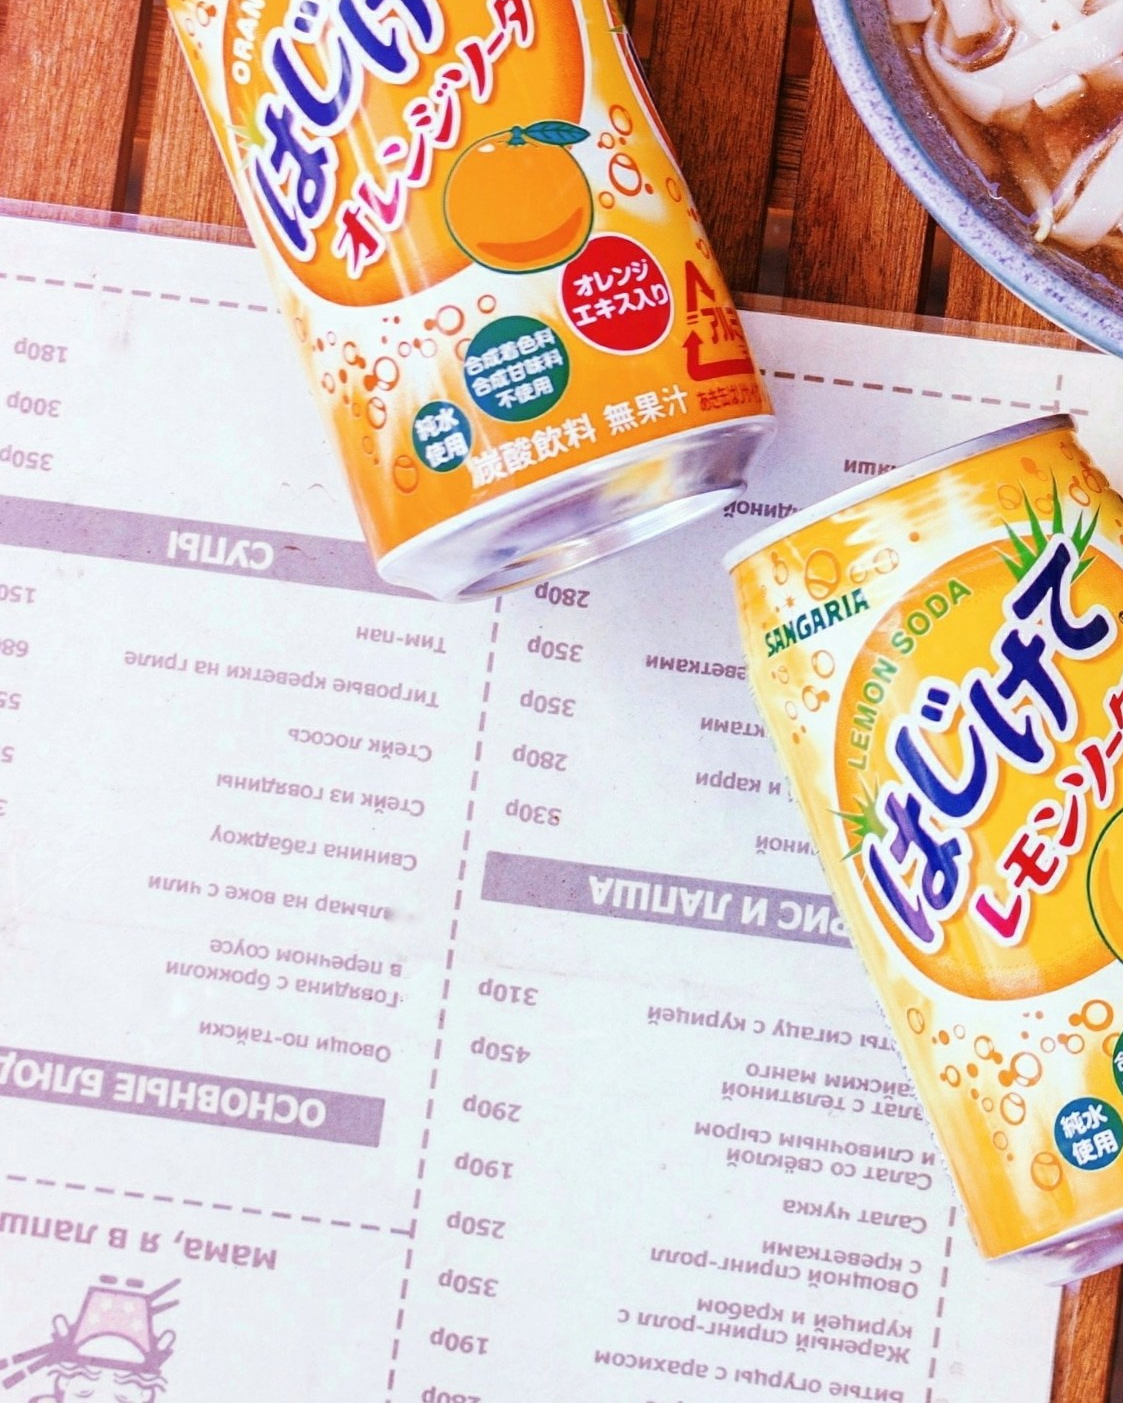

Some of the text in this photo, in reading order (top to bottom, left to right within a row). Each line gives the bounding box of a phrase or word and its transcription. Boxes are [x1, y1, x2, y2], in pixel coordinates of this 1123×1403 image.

[572, 257, 650, 298] オレンジ
[571, 283, 670, 327] エキス入り
[12, 336, 69, 364] 180р
[464, 327, 556, 377] 合成着色料
[471, 348, 564, 398] 合成甘味料
[4, 389, 62, 419] 300р
[495, 375, 555, 411] 不使用
[423, 432, 470, 469] 使用
[470, 384, 690, 490] 炭酸飲料 無果汁
[165, 529, 275, 571] СУПЫ
[532, 579, 591, 609] 280р
[354, 624, 448, 655] Тим-пан
[763, 587, 871, 658] SANGARIA
[526, 633, 584, 664] 350р
[122, 649, 440, 710] Тигровые креветки на гриле
[846, 578, 974, 772] LEMON SODA
[518, 688, 577, 718] 350р
[286, 726, 433, 763] Стейк лосось
[510, 742, 569, 772] 280р
[867, 540, 1112, 945] はじけて
[215, 772, 426, 818] Стейк из говядины
[694, 769, 762, 793] карри
[208, 823, 418, 873] Свинина габаджоу
[146, 874, 202, 895] чили
[206, 881, 220, 898] с
[223, 883, 277, 906] воке
[281, 892, 309, 910] на
[587, 873, 733, 922] ЛАПША
[739, 895, 769, 927] И
[208, 936, 403, 978] в перечном соусе
[164, 959, 400, 1009] Говядина с брокколи
[476, 976, 539, 1007] 310р
[646, 1005, 747, 1032] курицей
[752, 1018, 766, 1035] с
[770, 1017, 854, 1046] сигацу
[197, 1019, 392, 1064] Овощи по-тайски
[468, 1034, 531, 1065] 450р
[0, 1049, 327, 1129] ОСНОВНЫЕ БЛЮД
[744, 1061, 817, 1085] манго
[460, 1092, 523, 1123] 290р
[720, 1079, 924, 1122] алат с телятиной
[1059, 1103, 1109, 1140] 純水
[693, 1120, 936, 1166] и сливочным сыром
[1070, 1128, 1119, 1166] 使用
[452, 1150, 515, 1181] 190р
[725, 1146, 934, 1192] Салат со свёклой
[444, 1209, 506, 1240] 250р
[781, 1197, 928, 1235] Салат чукка
[0, 1210, 278, 1271] мама, я в лапш
[760, 1239, 923, 1275] с креветками
[436, 1267, 499, 1298] 350р
[649, 1246, 919, 1300] Овощной спринг-ролл
[615, 1307, 911, 1365] Жареный спринг-ролл с
[695, 1296, 913, 1340] курицей и крабом
[428, 1326, 489, 1356] 190р
[592, 1348, 709, 1379] арахисом
[713, 1365, 729, 1381] с
[732, 1367, 823, 1394] огурцы
